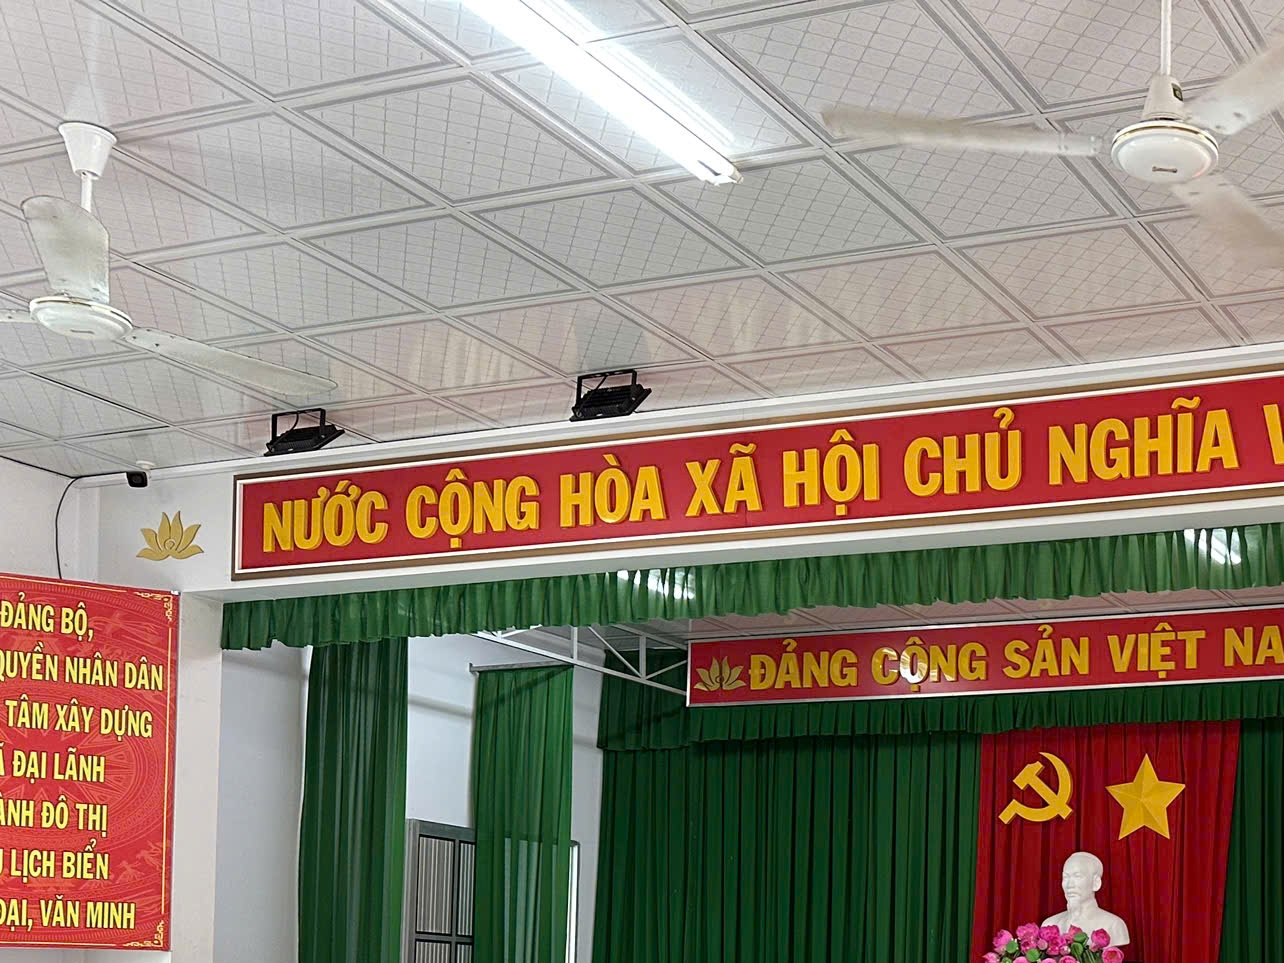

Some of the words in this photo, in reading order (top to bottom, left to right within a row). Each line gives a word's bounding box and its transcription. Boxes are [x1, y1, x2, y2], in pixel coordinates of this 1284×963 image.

[264, 480, 388, 552] NƯỚC
[406, 469, 539, 548] CỘNG
[560, 454, 666, 527] HÒA
[686, 444, 762, 516] XÃ
[783, 429, 879, 515] HỘI
[904, 408, 1021, 496] CHỦ
[1049, 397, 1238, 484] NGHĨA
[0, 592, 54, 632] ĐẢNG
[61, 602, 93, 640] BỘ,
[66, 652, 117, 686] NHÂN
[125, 657, 162, 690] DÂN
[749, 639, 857, 689] ĐẢNG
[872, 637, 986, 691] CỘNG
[1003, 625, 1088, 678] SẢN
[1108, 623, 1205, 678] VIỆT
[6, 695, 48, 729] TÂM
[56, 699, 93, 732] XÂY
[101, 705, 152, 741] DỰNG
[13, 751, 46, 783] ĐẠI
[54, 748, 104, 782] LÃNH
[41, 795, 68, 829] ĐÔ
[76, 804, 107, 837] THỊ
[11, 850, 54, 882] LỊCH
[63, 839, 108, 879] BIỂN
[40, 896, 79, 927] VĂN
[87, 902, 135, 929] MINH
